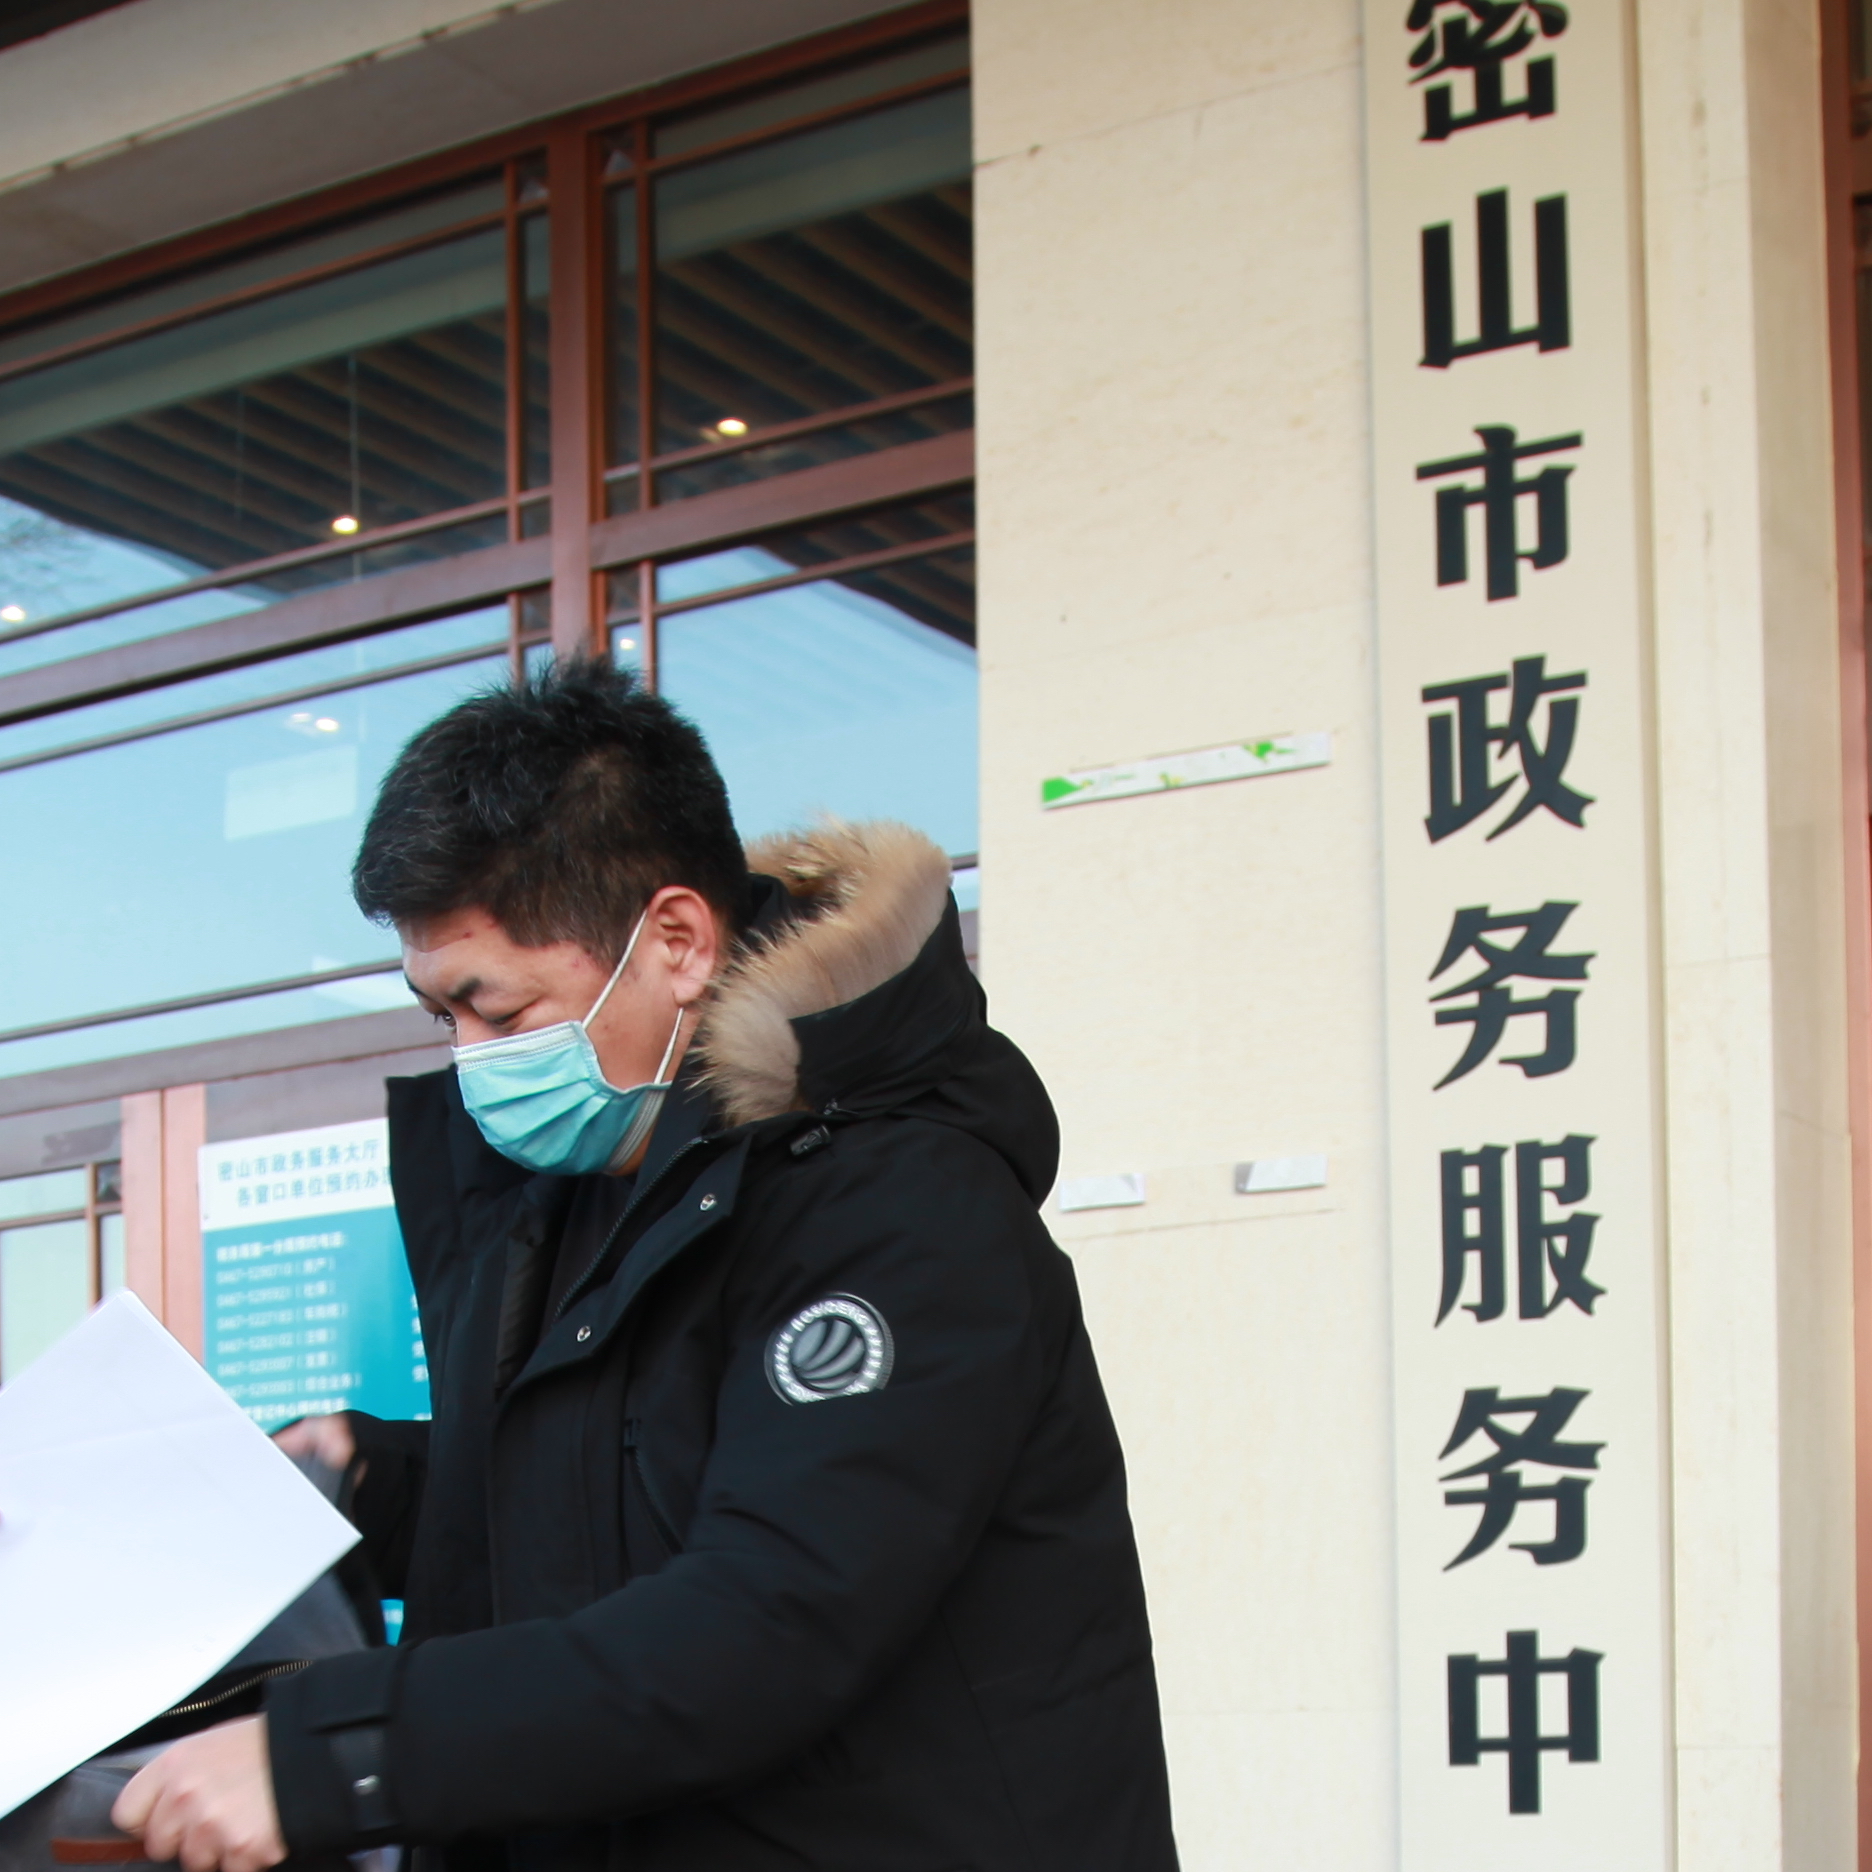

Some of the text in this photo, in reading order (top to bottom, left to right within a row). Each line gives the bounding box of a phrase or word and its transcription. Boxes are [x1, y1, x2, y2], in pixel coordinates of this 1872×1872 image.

[217, 1138, 380, 1182] 密山市政务服务大厅
